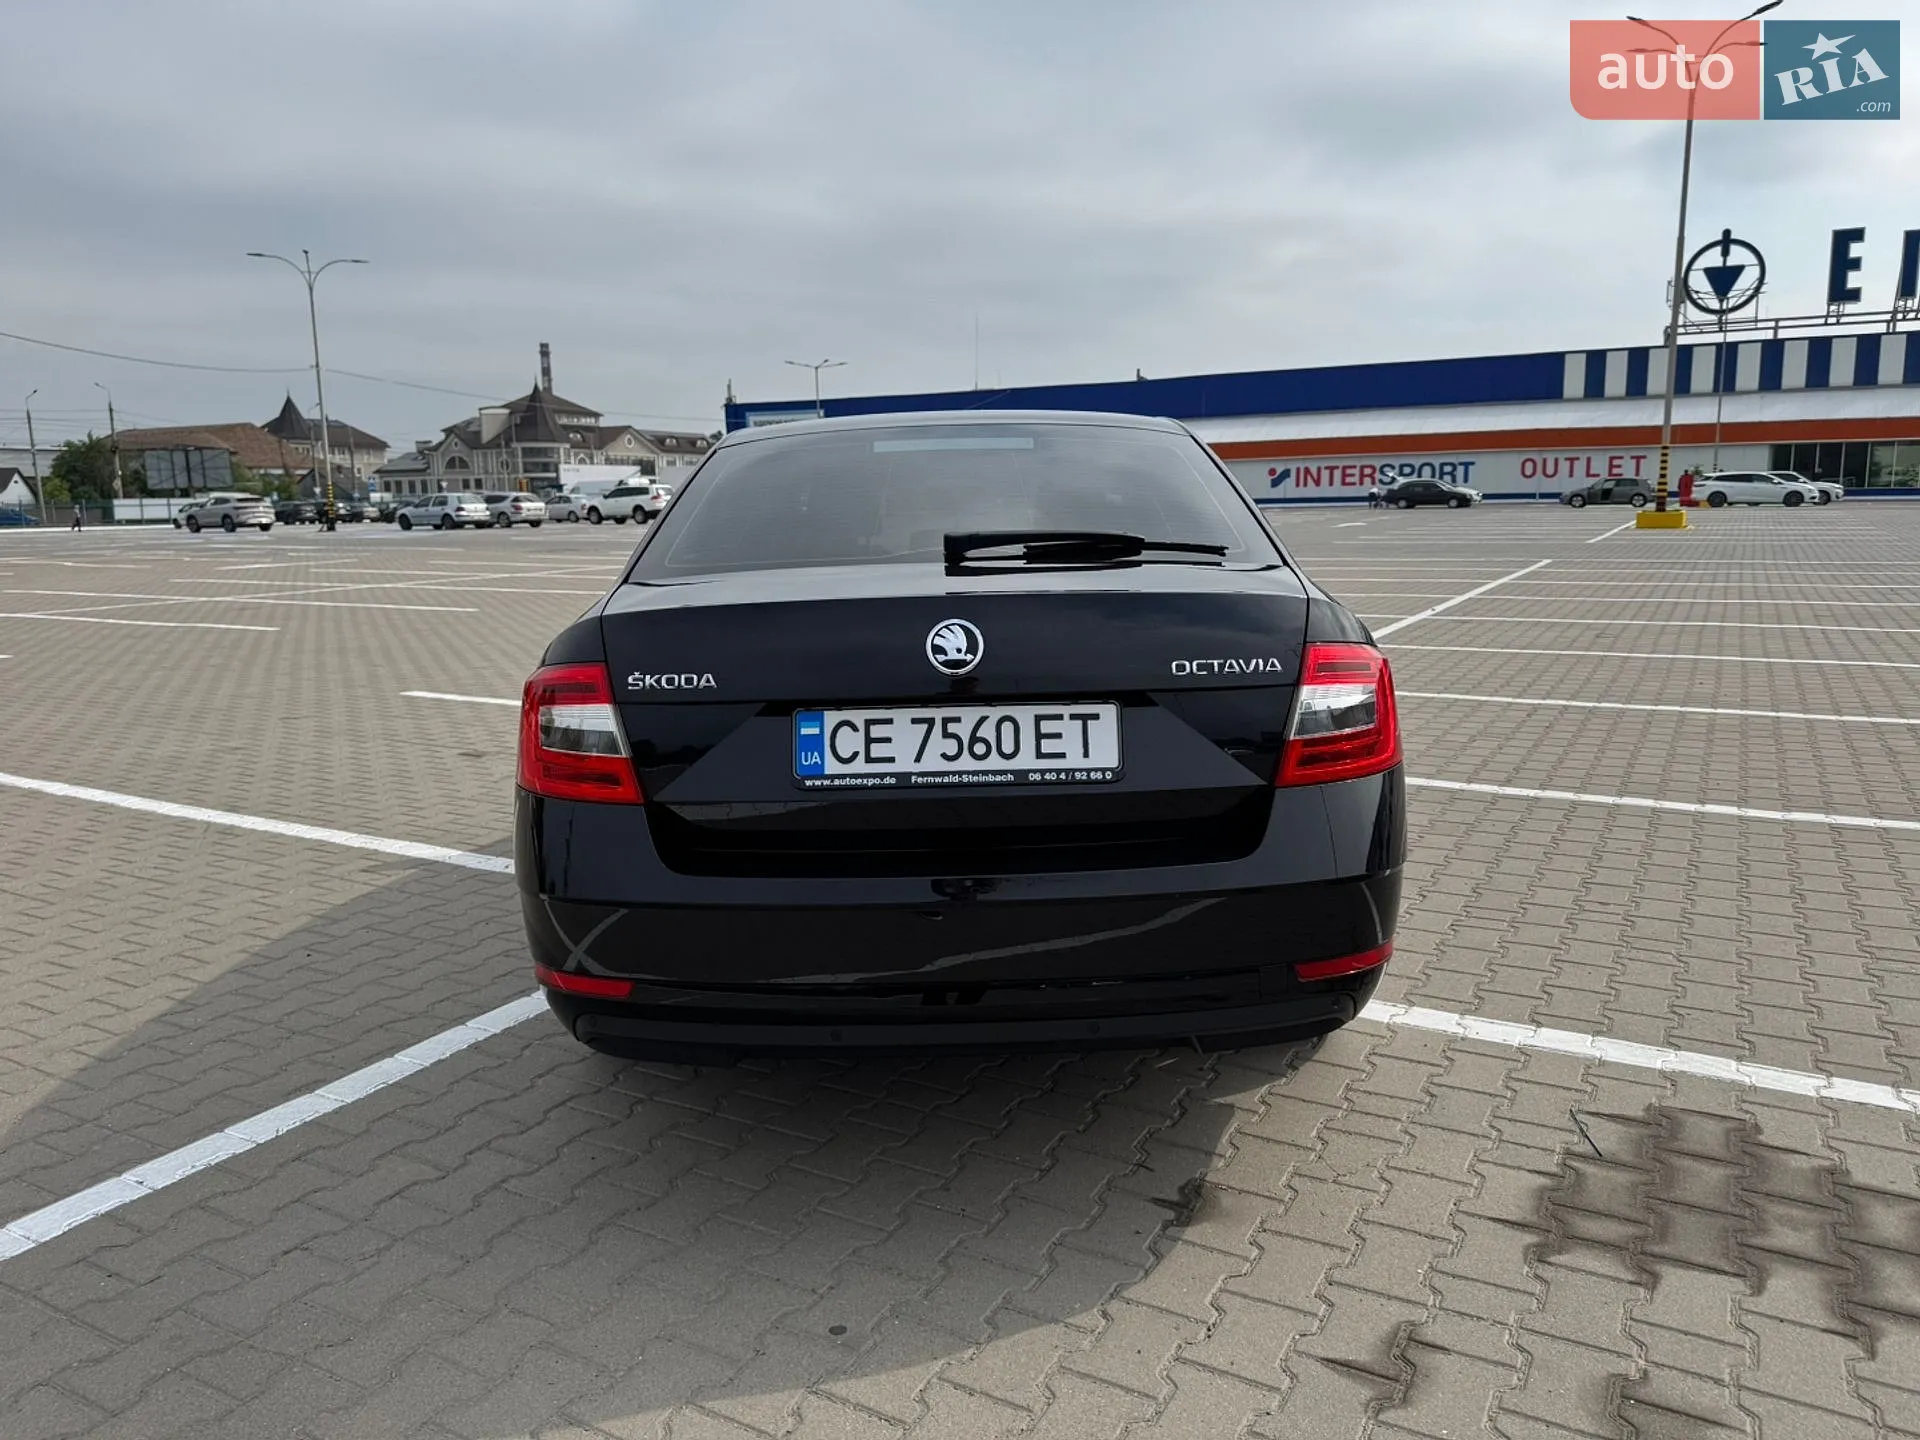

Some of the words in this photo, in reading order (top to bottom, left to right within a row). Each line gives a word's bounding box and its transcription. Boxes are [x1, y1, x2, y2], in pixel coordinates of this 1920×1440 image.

[1295, 461, 1475, 488] INTERSPORT
[1520, 455, 1647, 479] OUTLET
[1171, 657, 1283, 675] OCTAVIA
[627, 671, 718, 690] ŠKODA
[829, 717, 896, 765] CE
[910, 714, 1021, 764] 7560
[1034, 712, 1101, 760] ET
[801, 751, 822, 766] UA
[804, 775, 897, 787] www.autoexpo.de
[911, 773, 1014, 784] Fernwald-Steinbach
